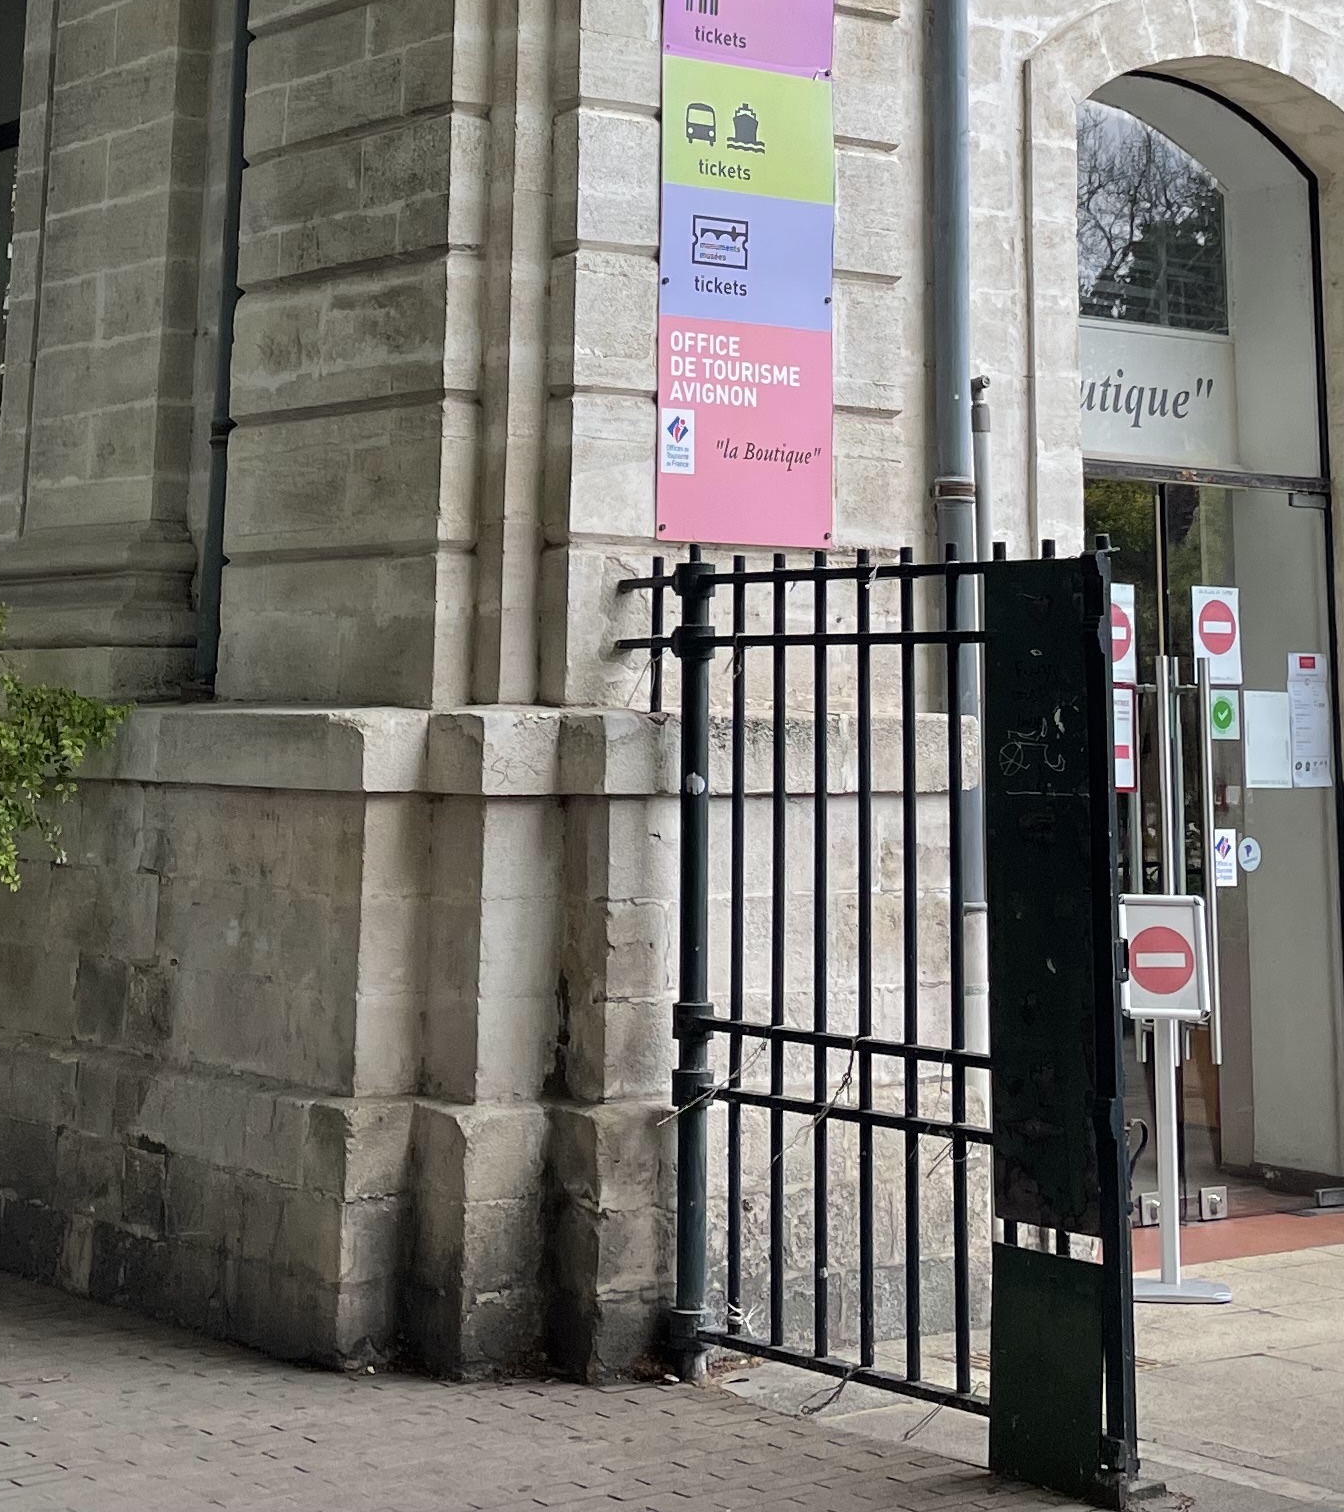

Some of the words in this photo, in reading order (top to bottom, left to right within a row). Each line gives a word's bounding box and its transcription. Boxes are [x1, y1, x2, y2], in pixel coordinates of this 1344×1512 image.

[694, 25, 747, 49] tickets
[698, 159, 751, 181] tickets
[694, 274, 747, 296] tickets
[670, 330, 741, 357] OFFICE
[670, 356, 697, 378] DE
[702, 357, 801, 387] TOURISME
[669, 380, 757, 408] AVIGNON
[716, 438, 739, 460] "la
[743, 441, 822, 472] Boutique"
